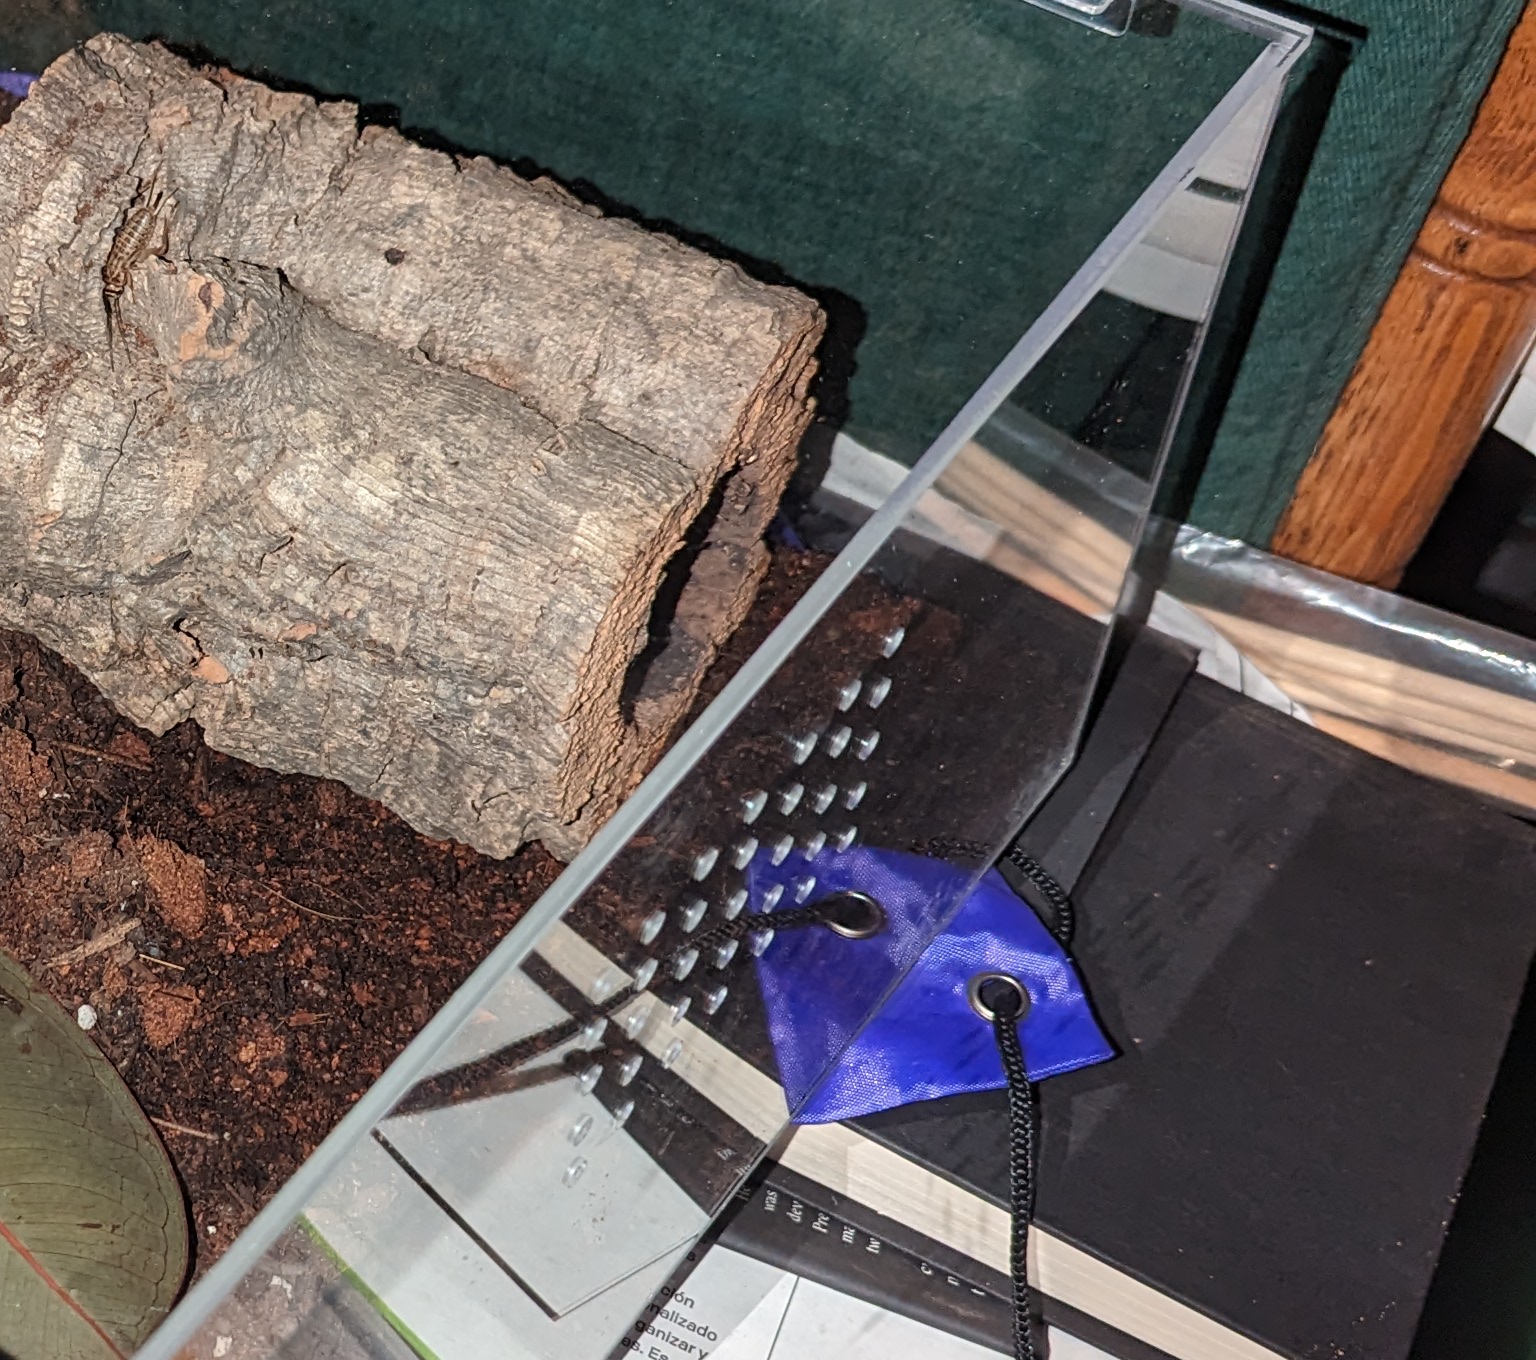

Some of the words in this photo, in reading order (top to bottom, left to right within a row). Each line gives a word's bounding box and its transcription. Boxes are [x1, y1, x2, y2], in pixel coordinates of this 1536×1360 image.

[660, 1285, 695, 1309] ción
[634, 1320, 696, 1354] ganizar
[697, 1349, 709, 1360] y
[645, 1303, 717, 1342] nalizado
